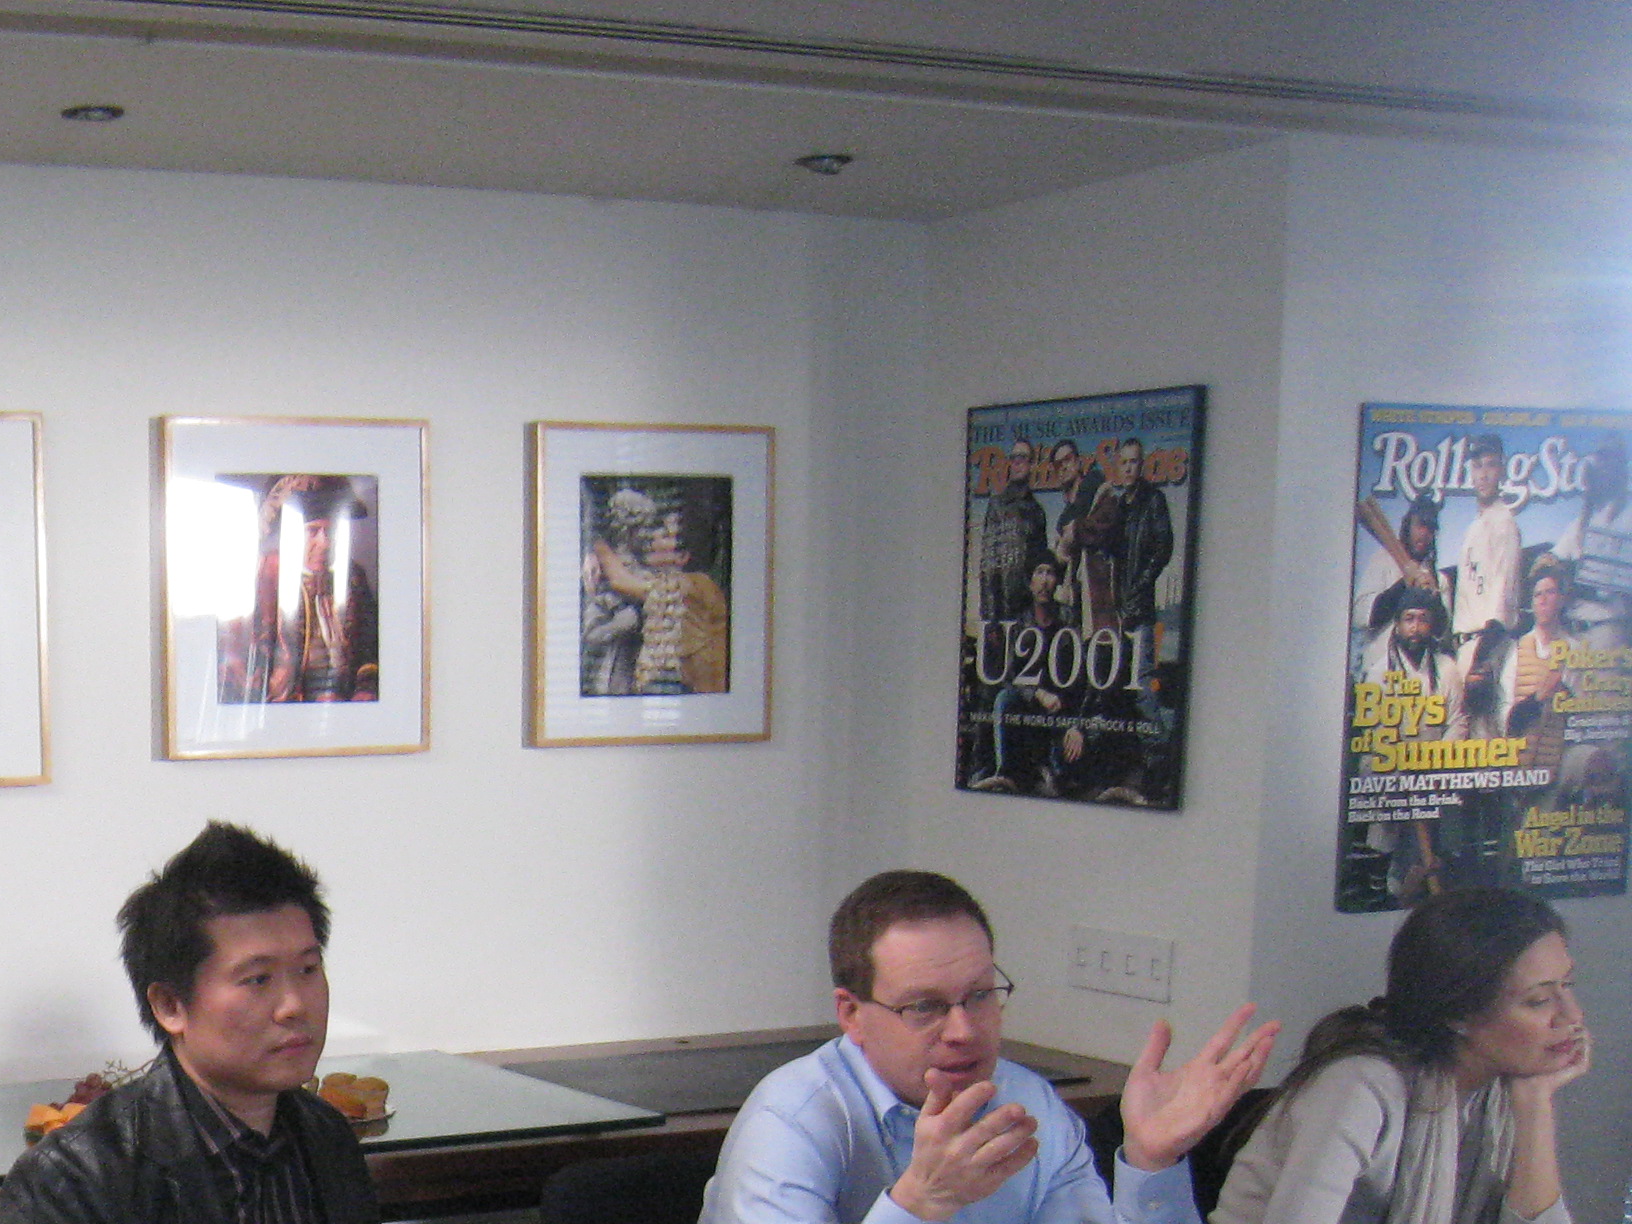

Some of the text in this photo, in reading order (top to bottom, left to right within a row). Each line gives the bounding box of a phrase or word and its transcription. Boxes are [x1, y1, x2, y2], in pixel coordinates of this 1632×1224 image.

[973, 425, 1004, 443] THE
[1012, 416, 1061, 440] MUSIC
[1067, 414, 1135, 437] AWARDS
[1372, 432, 1539, 509] Rollig
[1383, 670, 1422, 695] The
[1023, 714, 1053, 727] WORLD
[1352, 682, 1448, 736] Boys
[1350, 727, 1528, 773] of Summer
[1349, 769, 1550, 794] DAVE MATTHEWS BAND
[1348, 797, 1375, 810] Back
[1378, 796, 1408, 808] From
[1409, 793, 1427, 806] the
[1348, 810, 1375, 823] Back
[1392, 809, 1410, 820] the
